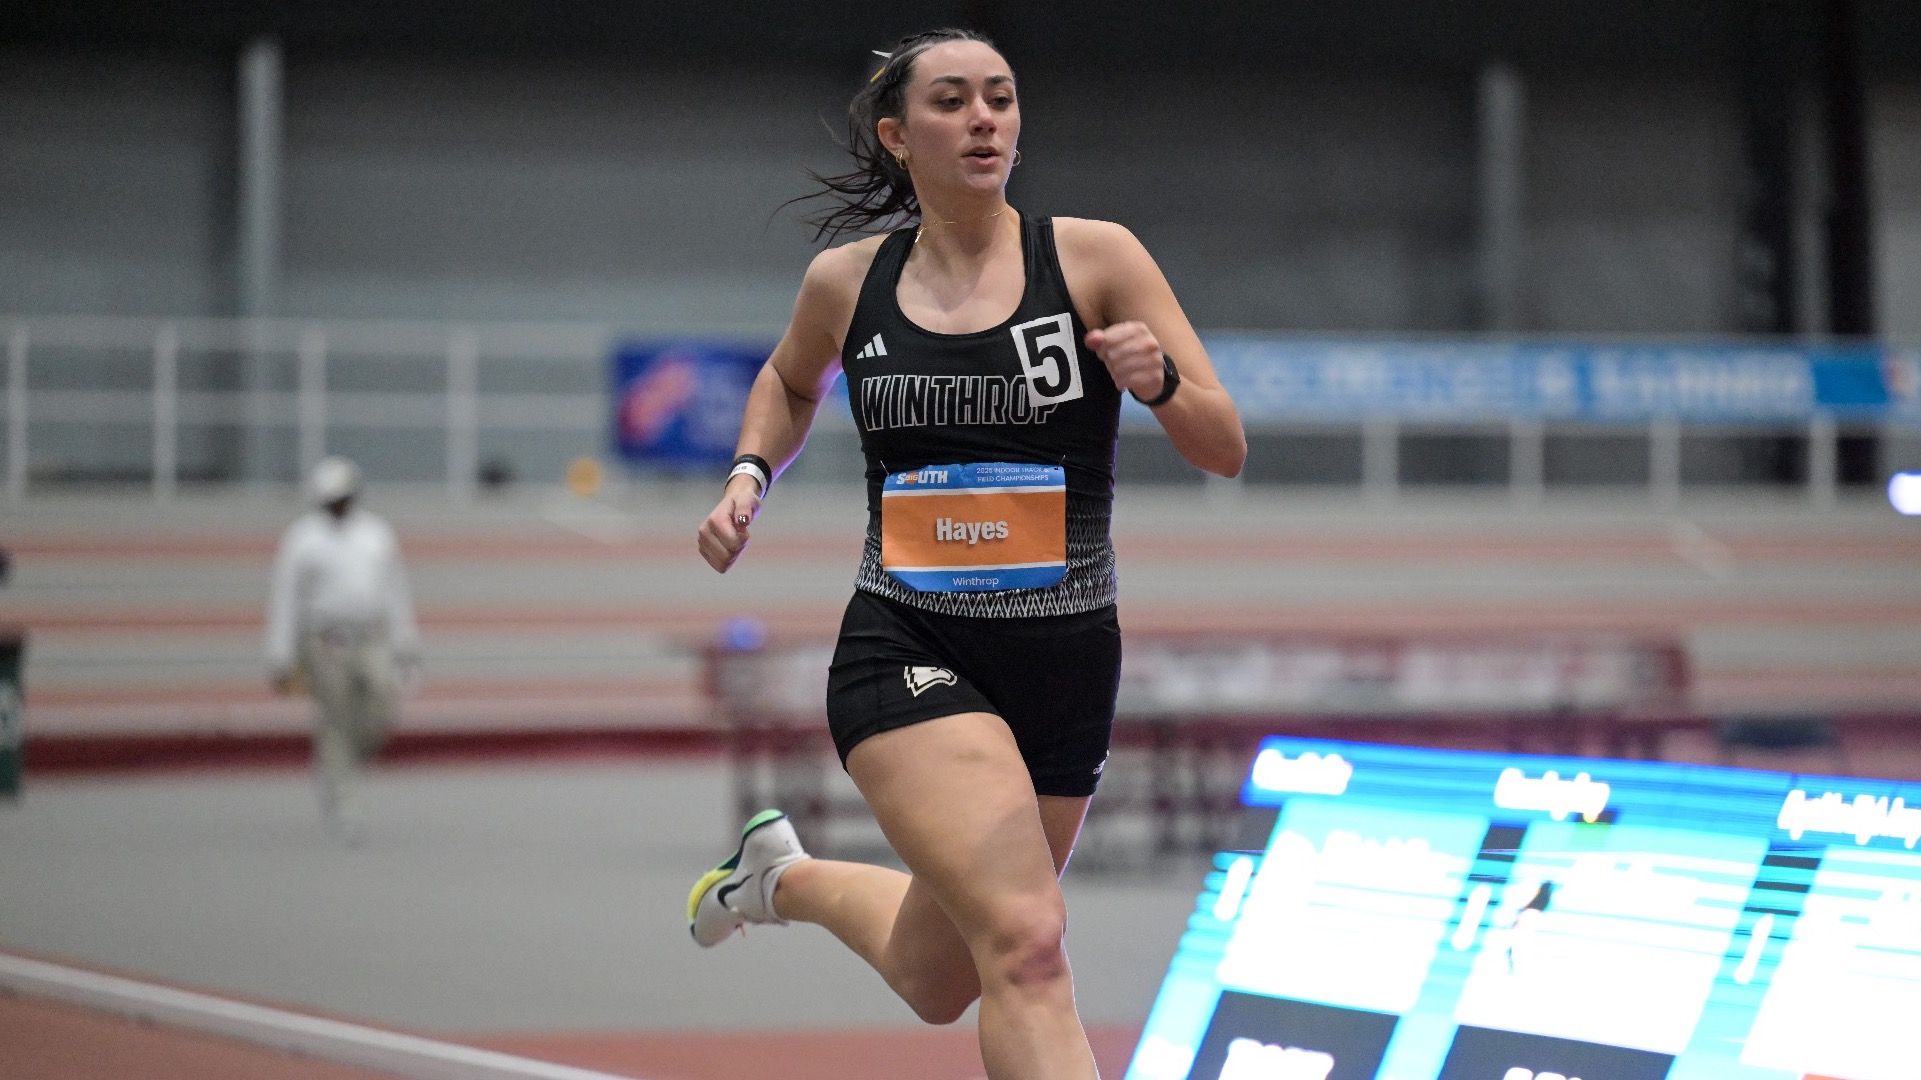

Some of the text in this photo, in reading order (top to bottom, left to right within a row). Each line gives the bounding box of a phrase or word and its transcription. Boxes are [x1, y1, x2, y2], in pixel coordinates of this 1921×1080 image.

[1021, 320, 1072, 399] 5
[995, 474, 1049, 482] CHAMPIONSHIPS
[936, 517, 1009, 545] Hayes
[952, 576, 1000, 588] Winthrop
